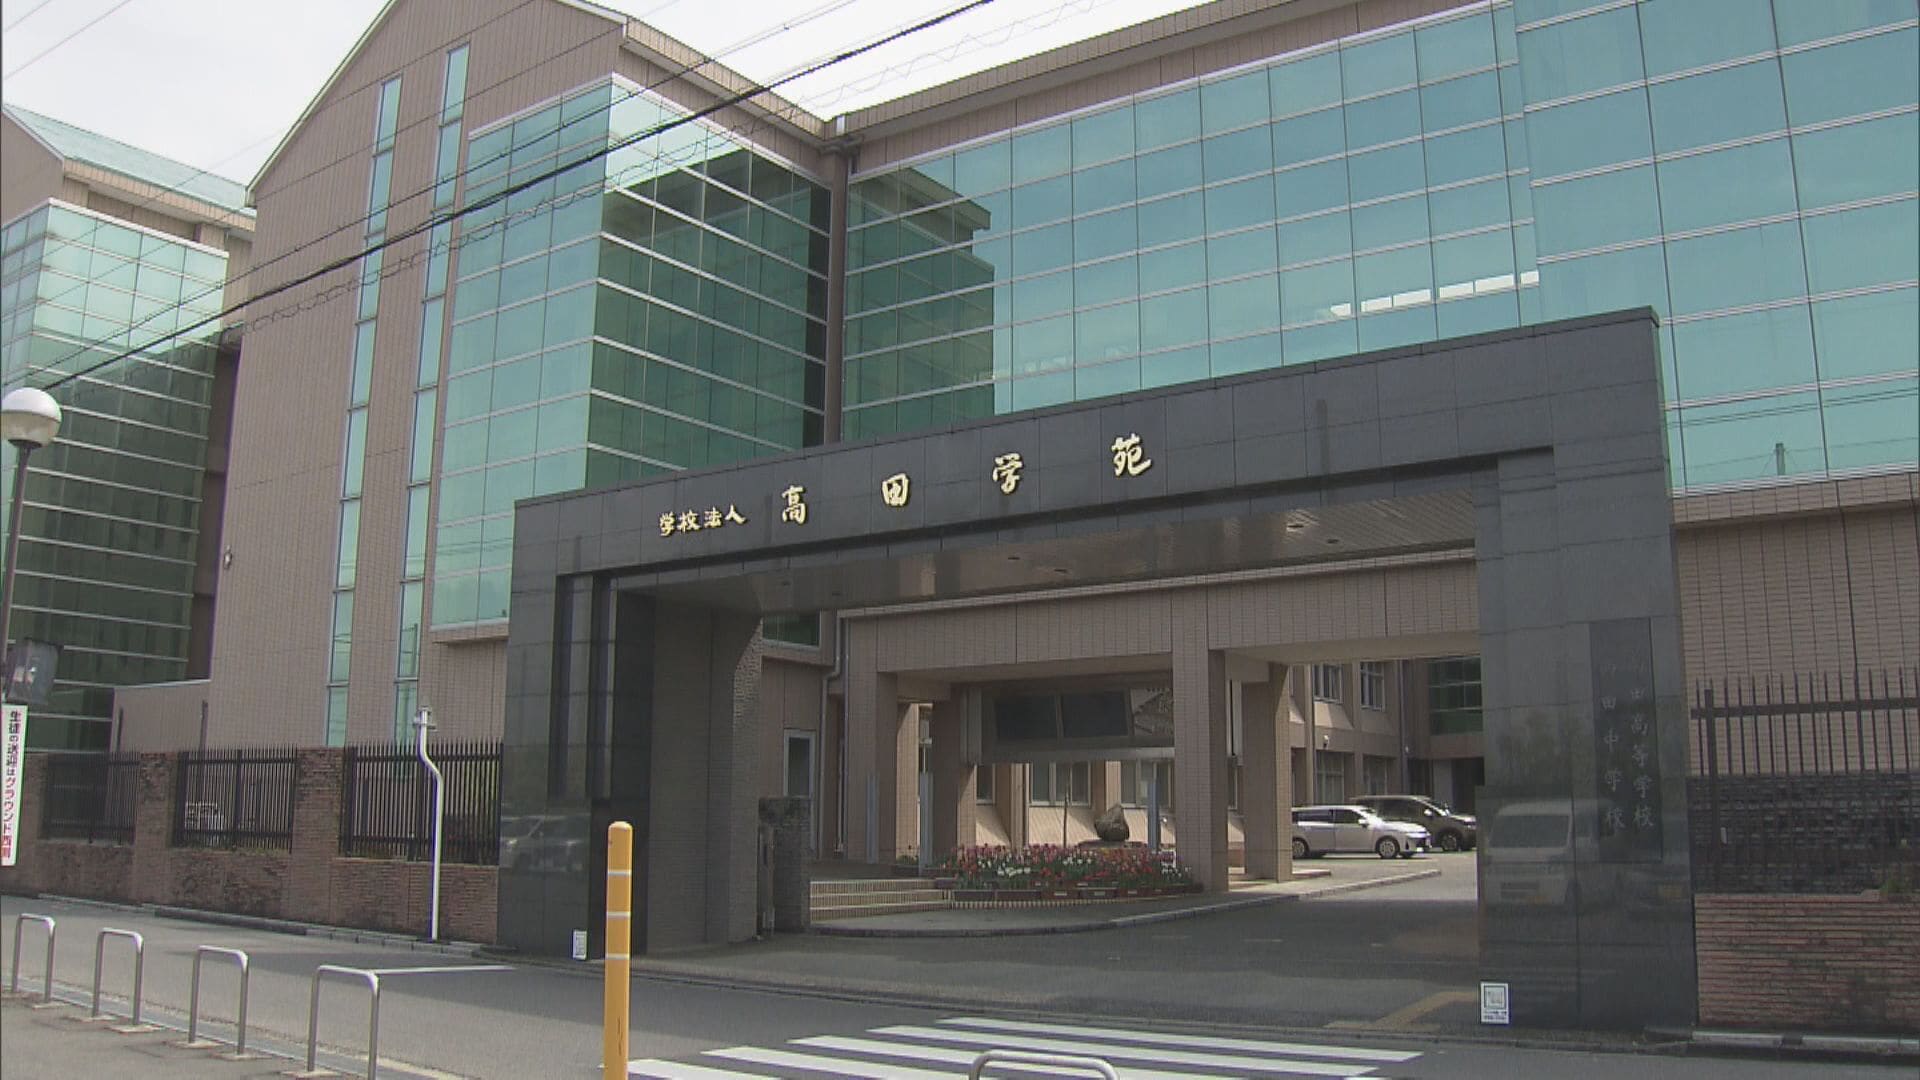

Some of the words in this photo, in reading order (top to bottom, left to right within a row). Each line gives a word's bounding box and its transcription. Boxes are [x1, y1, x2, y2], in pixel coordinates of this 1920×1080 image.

[659, 504, 747, 537] 学校法人
[781, 433, 1152, 525] 高田学苑
[1629, 650, 1655, 829] 田高等学校
